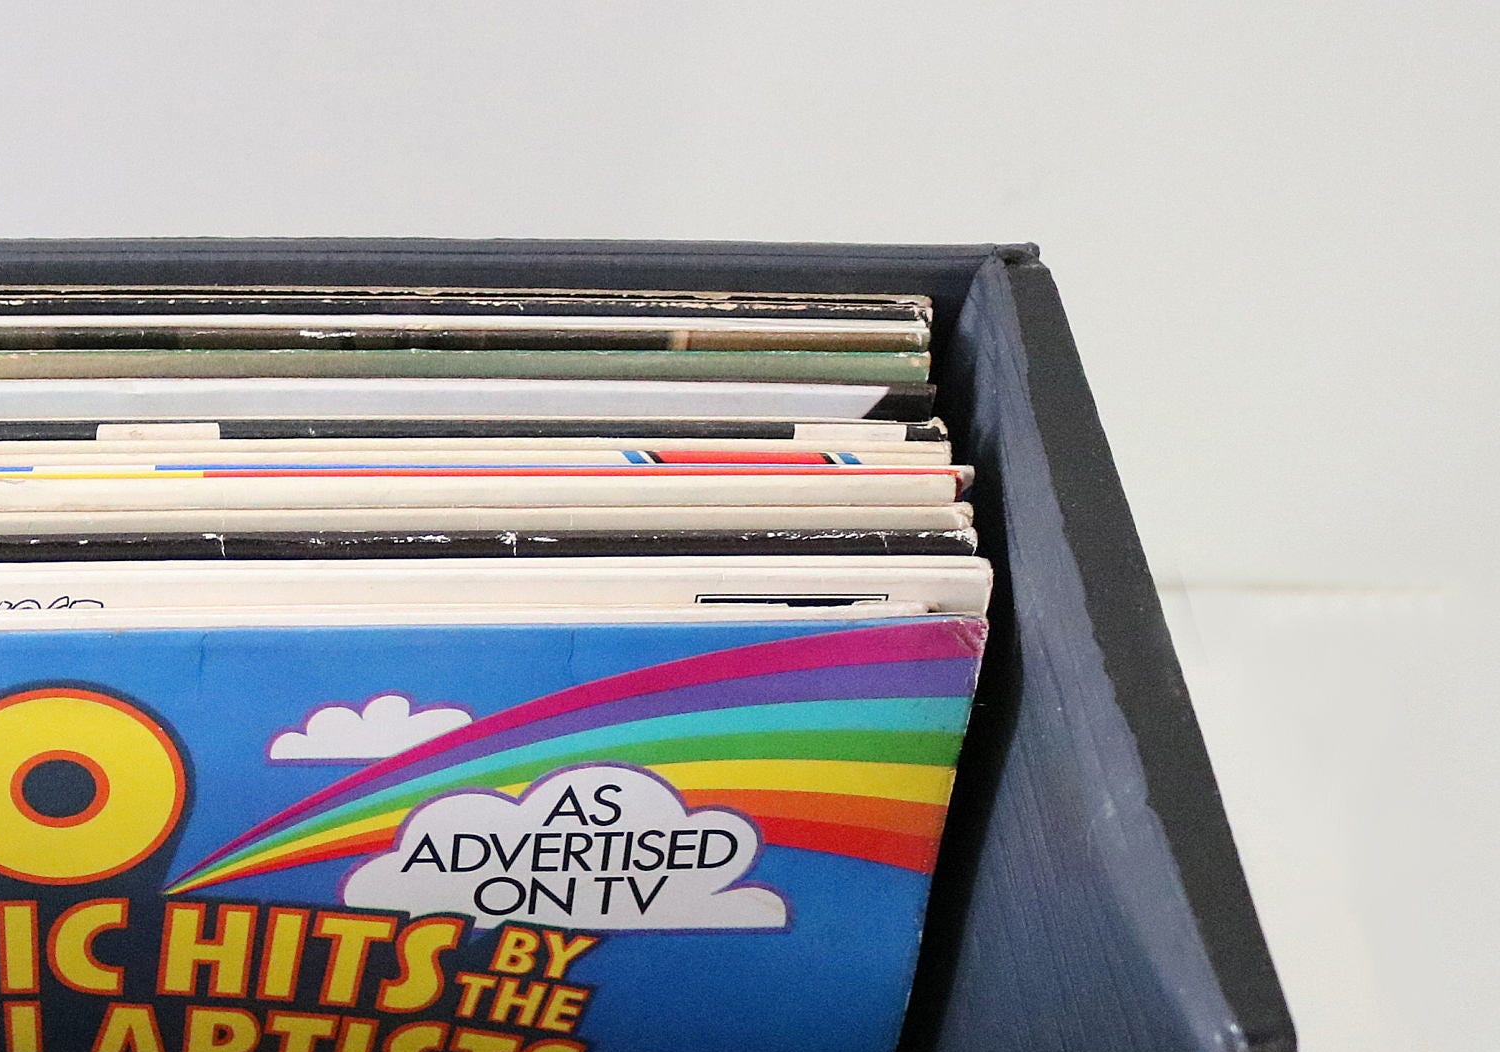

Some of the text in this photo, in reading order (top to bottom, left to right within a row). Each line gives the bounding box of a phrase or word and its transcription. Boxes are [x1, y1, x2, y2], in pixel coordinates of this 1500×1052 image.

[542, 784, 622, 826] AS
[400, 828, 738, 873] ADVERTISED
[473, 875, 669, 915] ON TV
[162, 901, 464, 1014] HITS
[493, 930, 597, 978] BY
[455, 972, 588, 1032] THE
